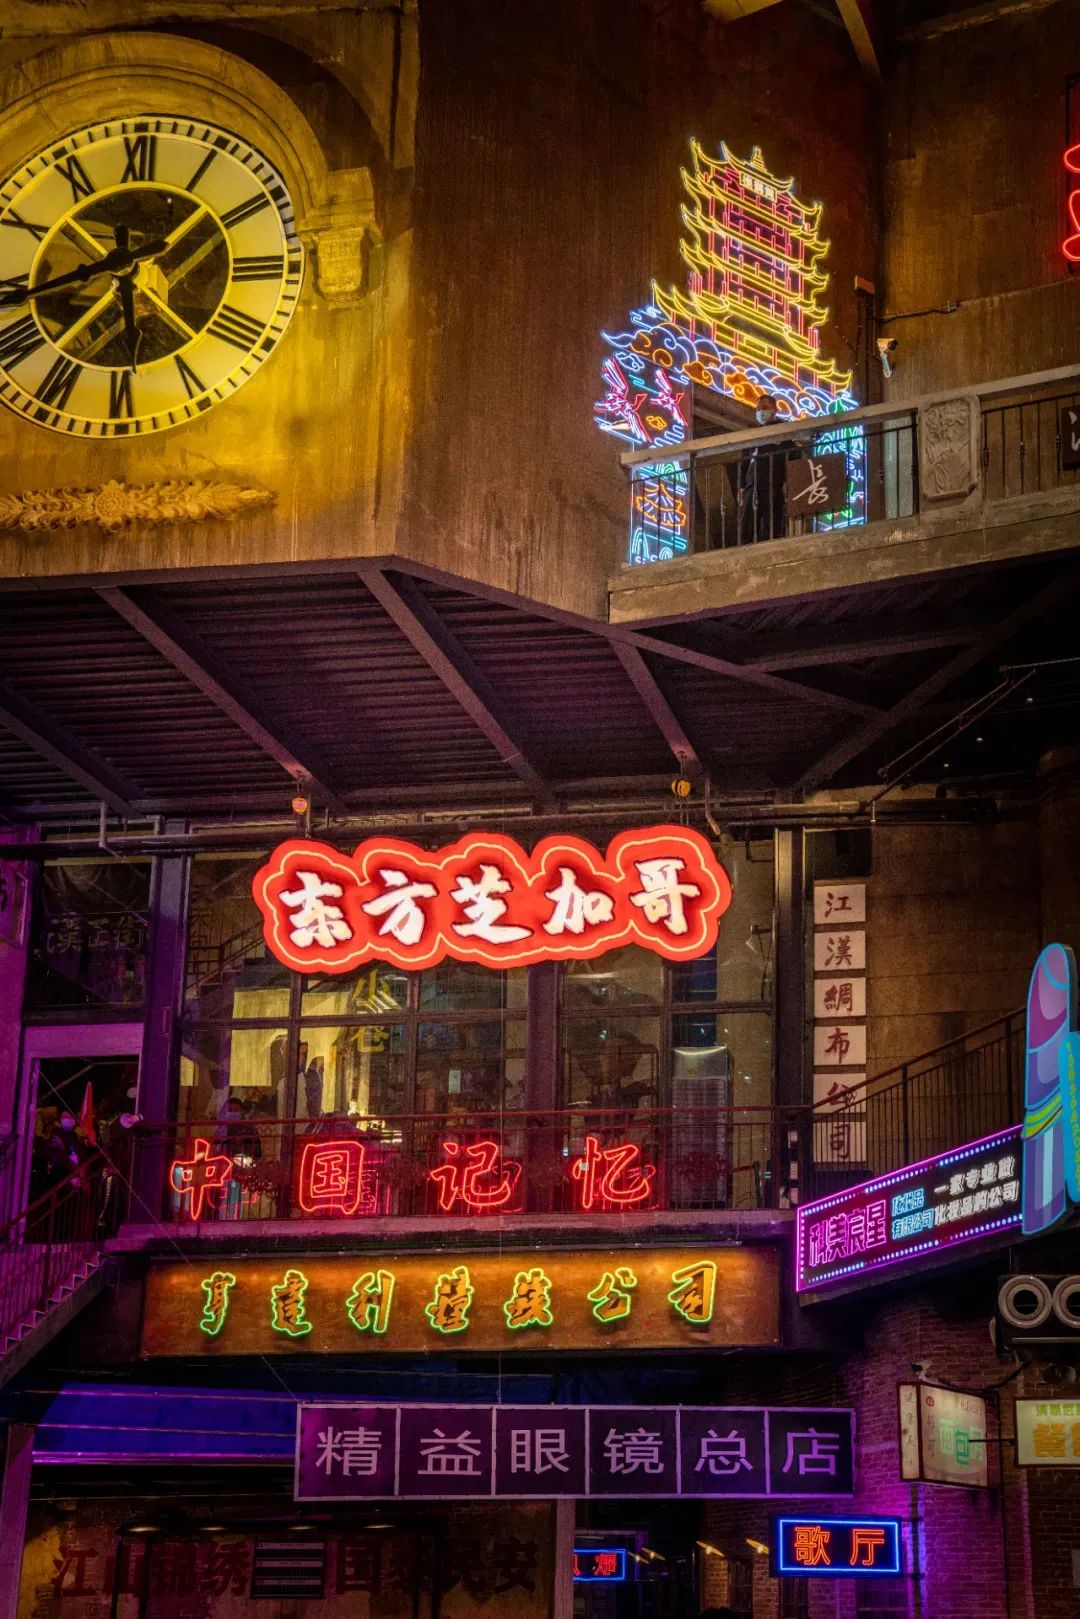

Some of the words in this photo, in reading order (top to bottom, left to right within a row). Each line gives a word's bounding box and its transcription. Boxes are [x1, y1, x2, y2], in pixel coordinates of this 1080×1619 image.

[280, 858, 700, 949] 东方芝加哥
[170, 1137, 654, 1221] 中国记忆
[891, 1207, 935, 1240] 有限公司
[315, 1425, 840, 1478] 精益眼镜总店
[794, 1526, 884, 1567] 歌厅
